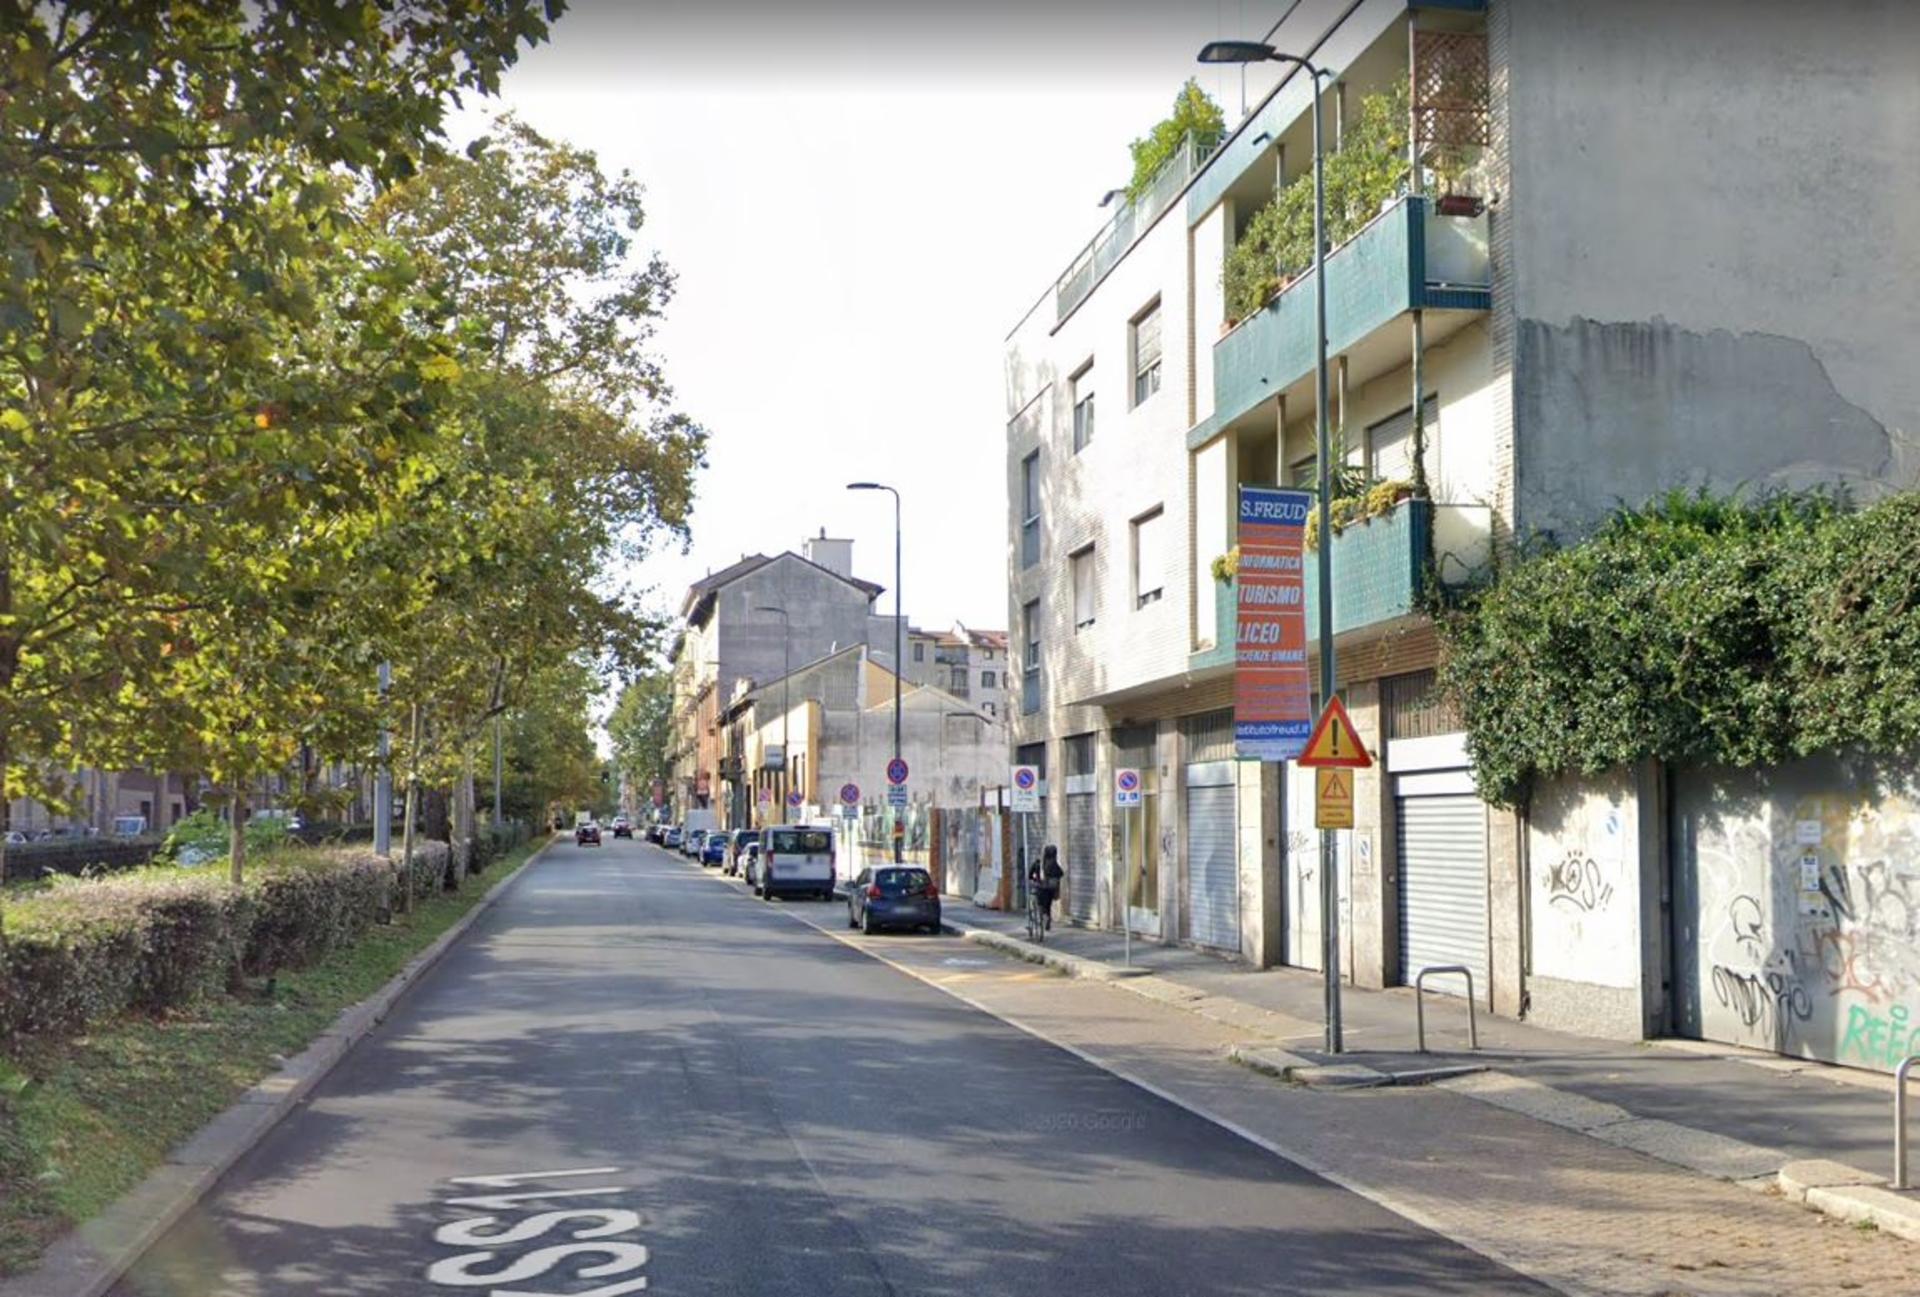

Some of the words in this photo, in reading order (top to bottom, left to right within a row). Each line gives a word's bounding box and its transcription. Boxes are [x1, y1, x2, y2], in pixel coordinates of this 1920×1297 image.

[1240, 500, 1306, 519] S.FREUD
[1239, 555, 1301, 569] INFORMATICA
[1239, 585, 1300, 605] TURISMO
[1236, 622, 1280, 644] LICEO
[1272, 650, 1306, 662] UMANE
